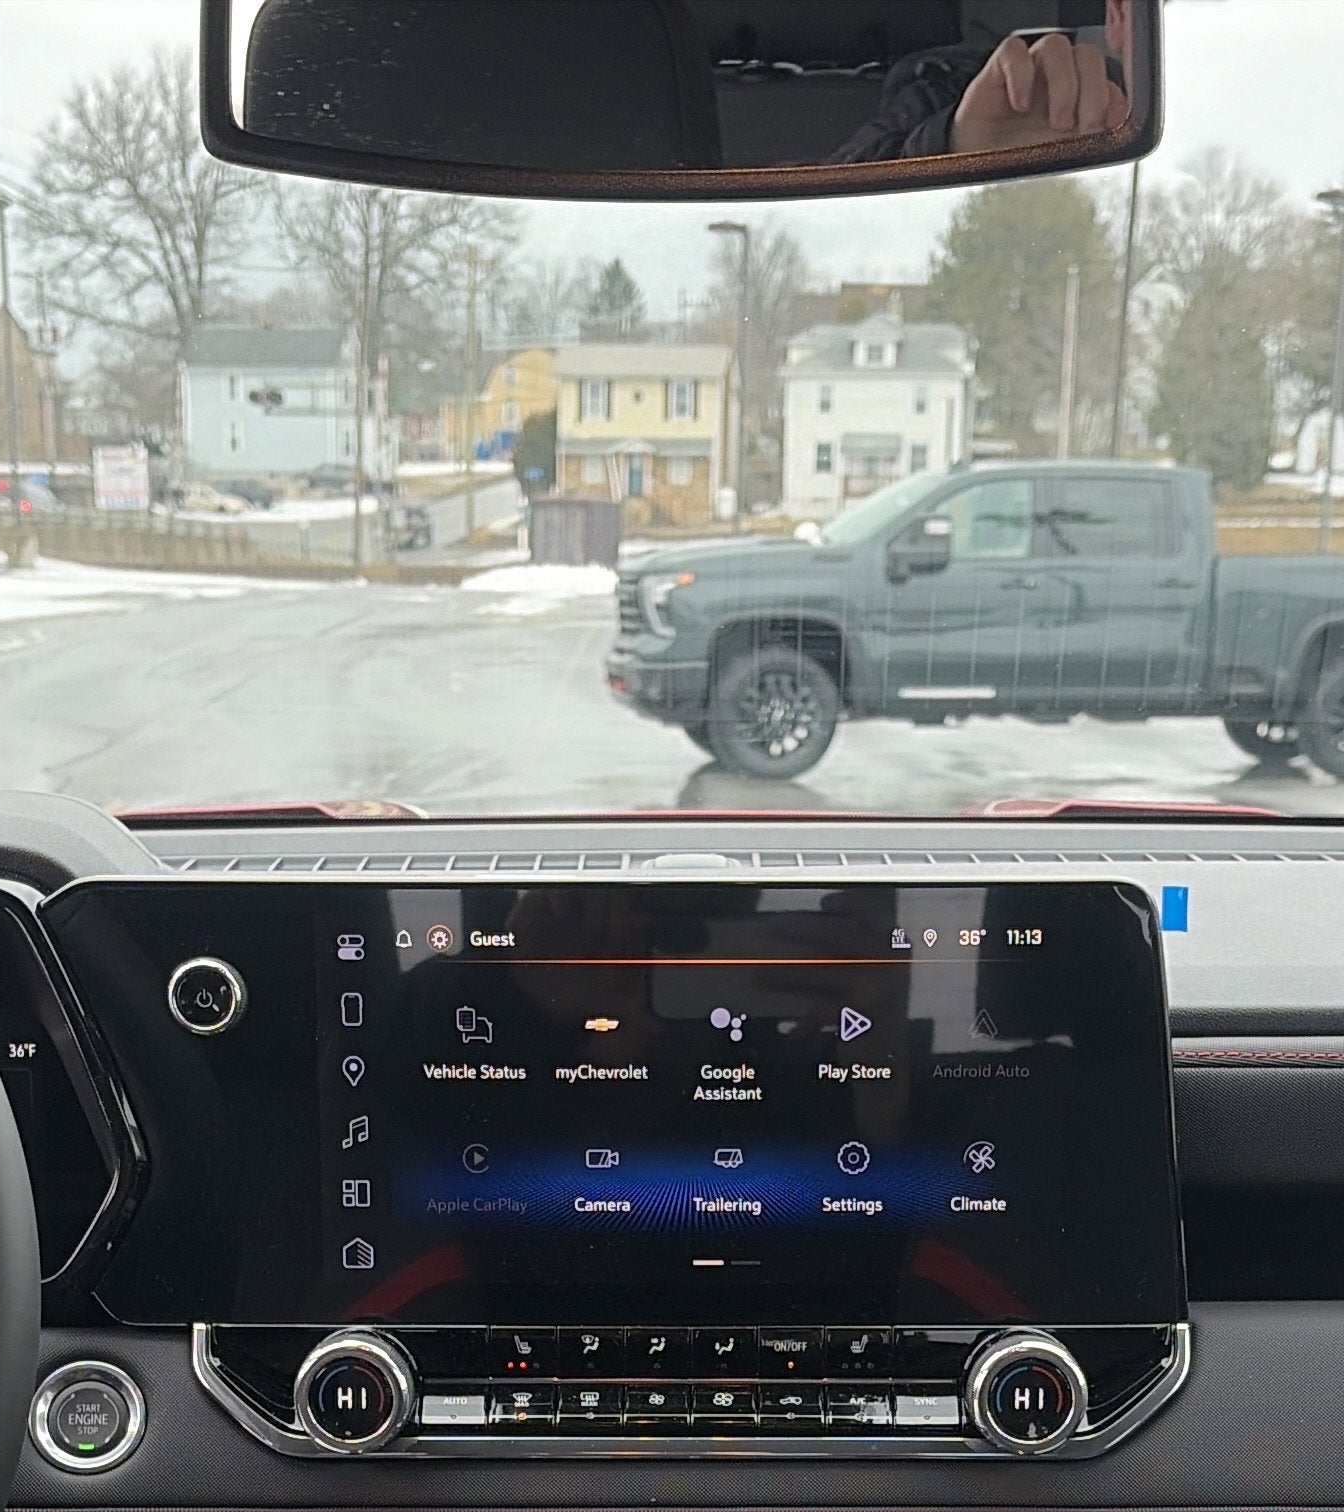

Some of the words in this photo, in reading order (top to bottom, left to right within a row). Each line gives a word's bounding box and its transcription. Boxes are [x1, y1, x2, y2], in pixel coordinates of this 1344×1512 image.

[470, 930, 515, 948] Guest
[892, 928, 905, 937] 4G
[958, 928, 987, 945] 36°
[1006, 929, 1043, 945] 11:13
[8, 1043, 37, 1058] 36°F
[423, 1064, 475, 1080] Vehicle
[479, 1064, 526, 1080] Status
[555, 1064, 648, 1083] myChevrolet
[699, 1064, 756, 1084] Google
[818, 1064, 849, 1084] Play
[851, 1064, 892, 1081] Store
[932, 1063, 991, 1080] Android
[994, 1063, 1030, 1080] Auto
[692, 1084, 762, 1102] Assistant
[426, 1196, 470, 1216] Apple
[473, 1196, 529, 1216] CarPlay
[574, 1197, 632, 1213] Camera
[692, 1196, 762, 1217] Trailering
[822, 1196, 884, 1217] Settings
[950, 1196, 1007, 1213] Climate
[773, 1341, 808, 1352] ON/OFF
[336, 1387, 368, 1410] HI
[442, 1396, 468, 1406] AUTO
[913, 1397, 938, 1406] SYNC
[1013, 1387, 1045, 1410] HI
[76, 1403, 101, 1413] START
[68, 1414, 109, 1426] ENGINE
[77, 1426, 99, 1435] STOP
